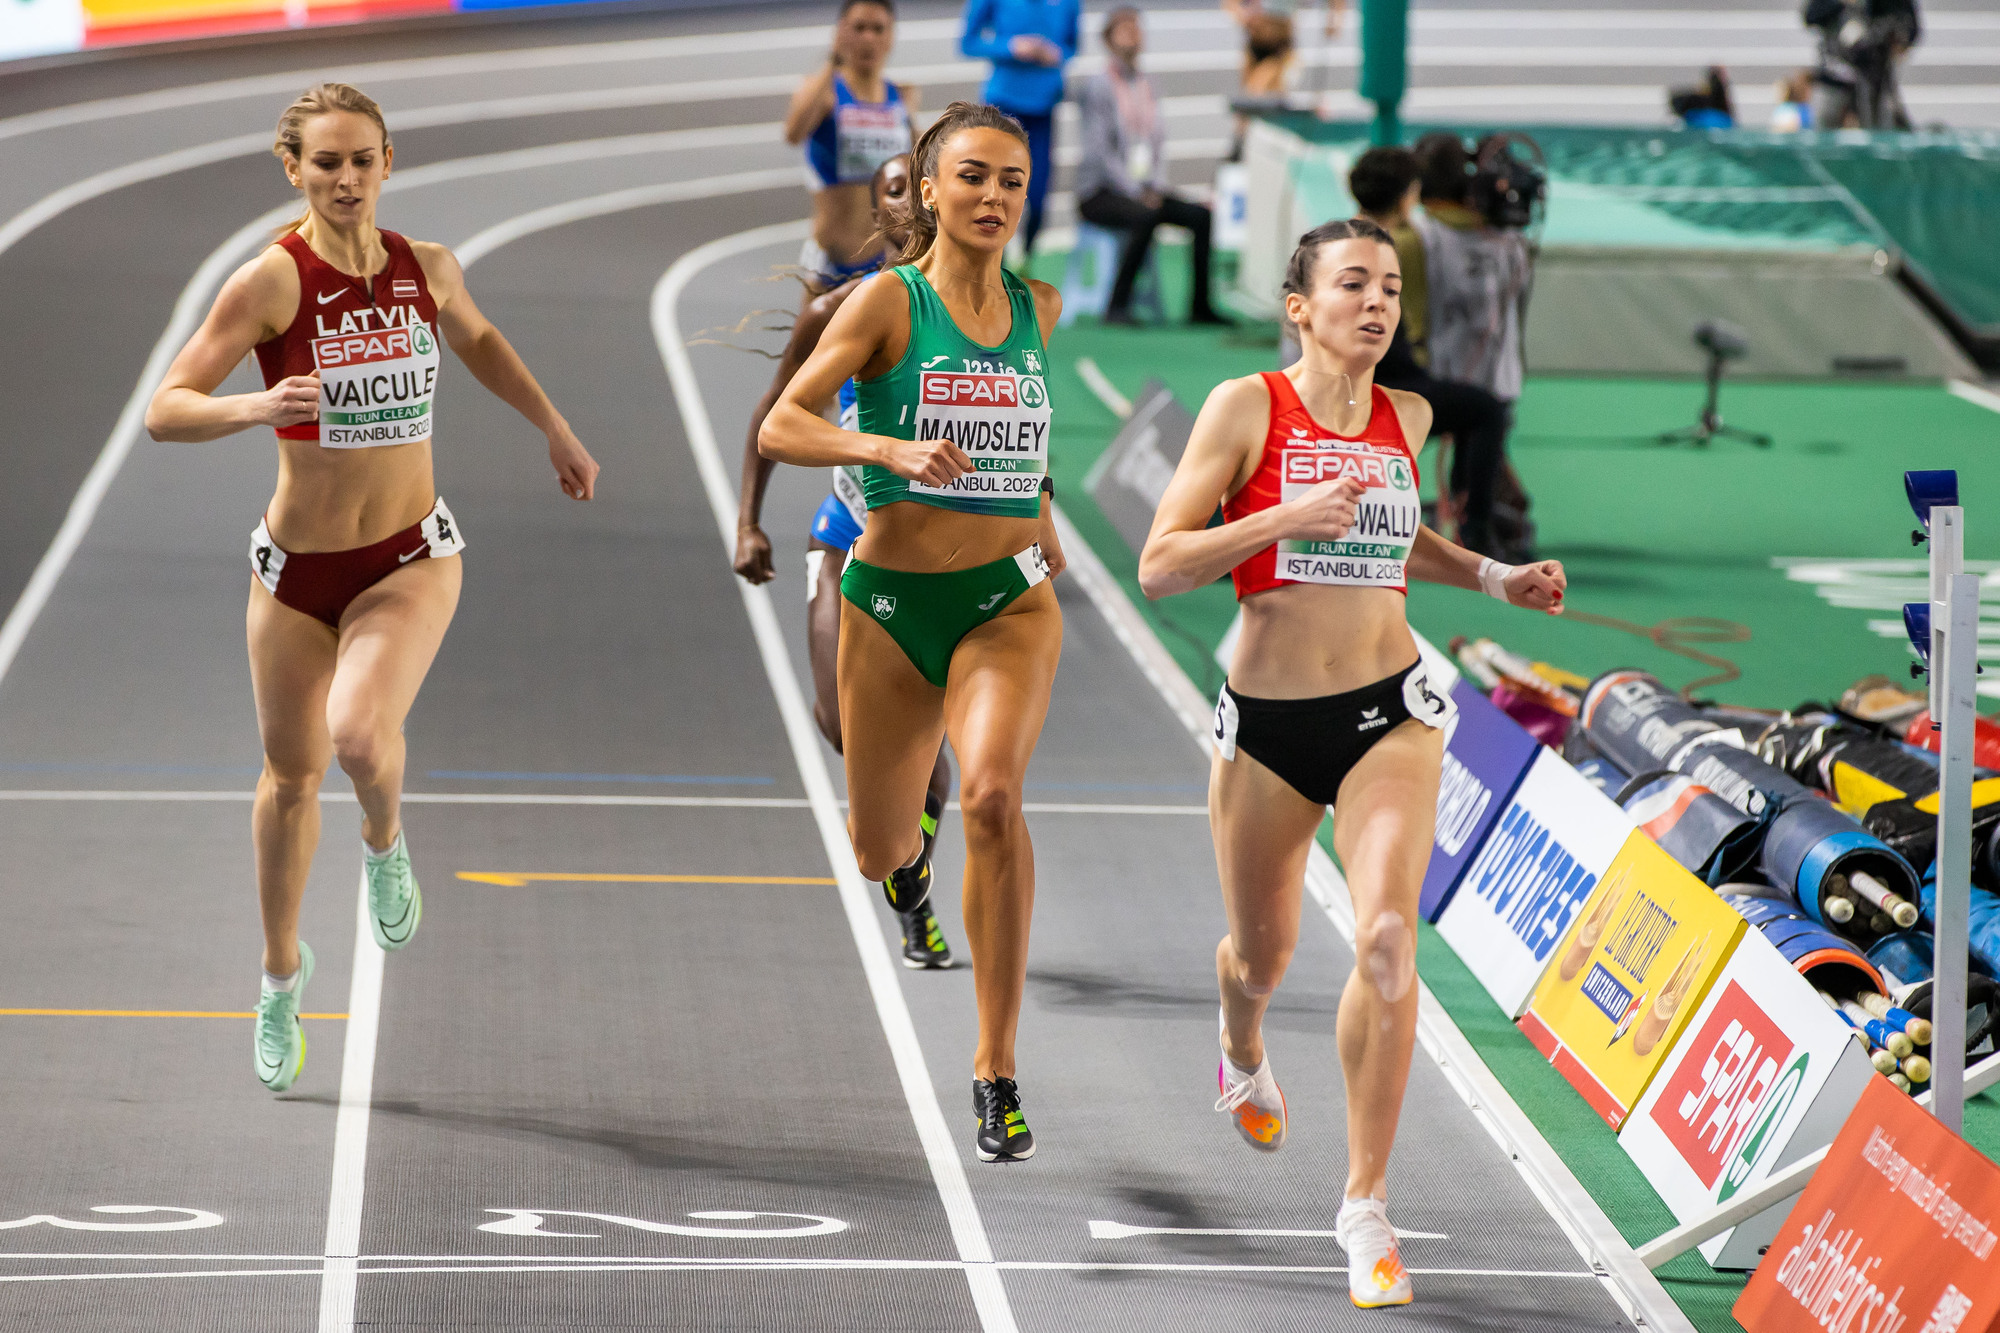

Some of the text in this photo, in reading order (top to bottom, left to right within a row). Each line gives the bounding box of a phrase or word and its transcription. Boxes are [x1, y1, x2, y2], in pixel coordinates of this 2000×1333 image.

[315, 304, 424, 337] LATVIA
[319, 332, 410, 365] SPAR
[322, 366, 436, 407] VAICULE
[926, 377, 1016, 403] SPAR
[328, 425, 405, 443] ISTANBUL
[355, 412, 380, 424] RUN
[920, 418, 1047, 452] MAWDSLEY
[1289, 456, 1385, 483] SPAR
[1318, 542, 1347, 555] RUN
[1287, 559, 1373, 579] ISTANBUL
[1357, 717, 1388, 731] erima
[1470, 802, 1597, 962] TOYO TIRES
[1604, 890, 1645, 955] LE
[1583, 965, 1630, 1020] SWITZERLAND
[1678, 1018, 1778, 1166] SPAR
[1861, 1125, 1998, 1262] Watch every minute of every event on
